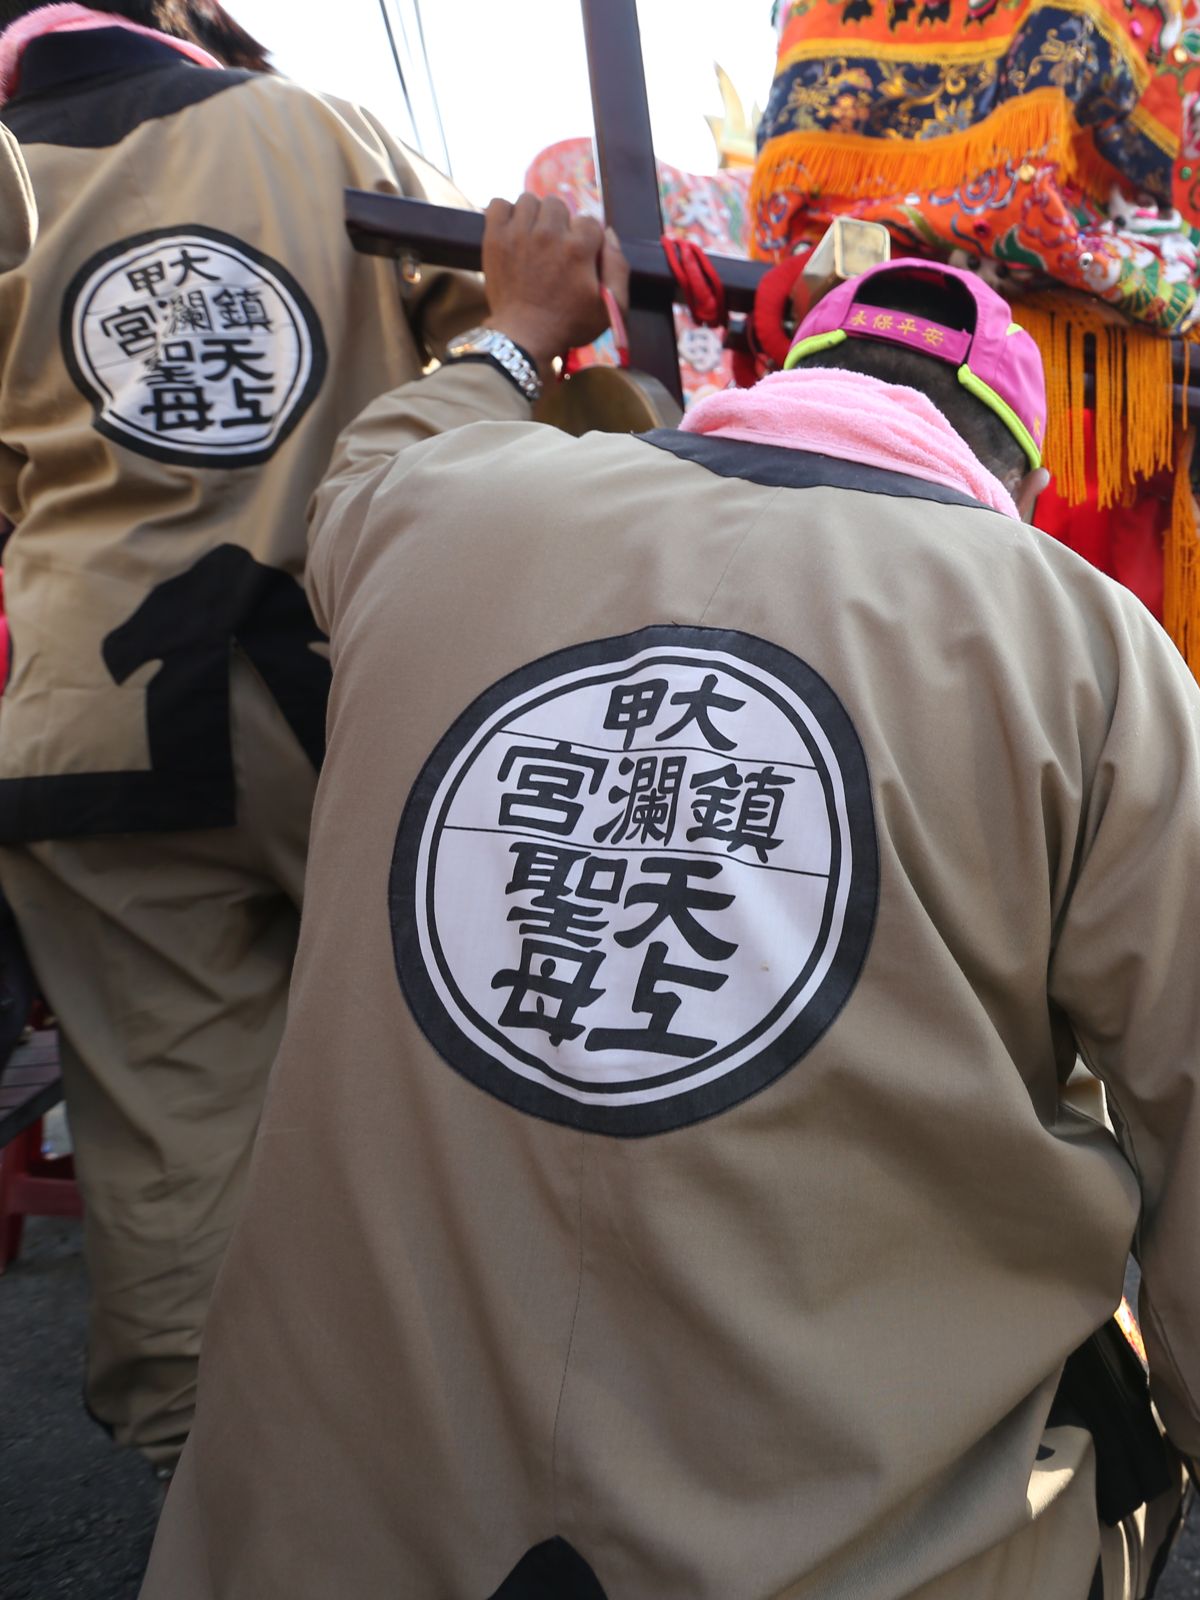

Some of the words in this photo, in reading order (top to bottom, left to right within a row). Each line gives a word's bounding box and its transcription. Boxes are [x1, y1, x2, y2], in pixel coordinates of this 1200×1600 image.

[126, 249, 222, 297] 大甲
[101, 289, 273, 357] 鎮瀾宮
[850, 310, 944, 347] 永保平安
[603, 674, 746, 750] 大甲
[498, 743, 796, 863] 鎮瀾宮
